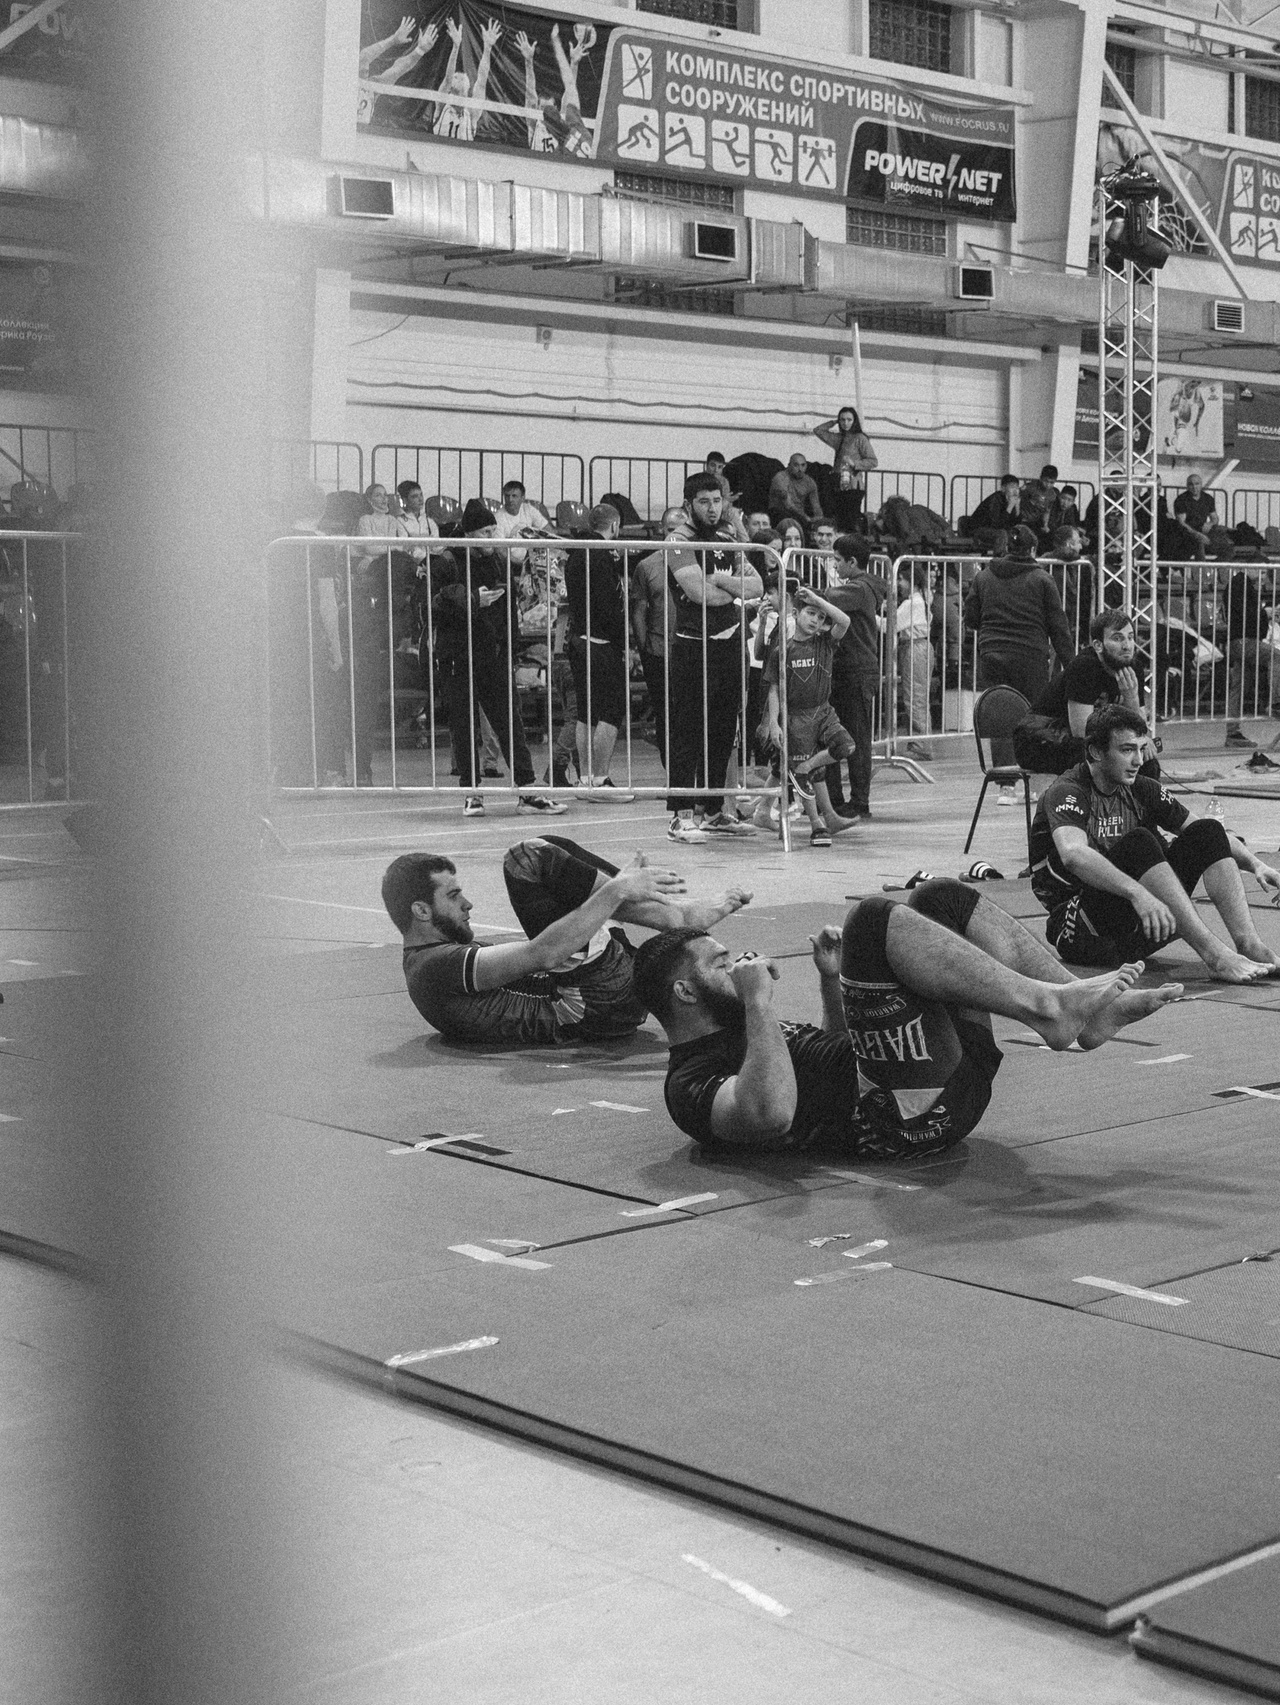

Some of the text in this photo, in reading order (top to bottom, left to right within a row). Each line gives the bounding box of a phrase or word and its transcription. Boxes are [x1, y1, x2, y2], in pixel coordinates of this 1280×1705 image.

[665, 50, 927, 123] КОМПЛЕКС СПОРТИВНЫХ
[665, 81, 815, 129] СООРУЖЕНИЙ
[864, 149, 1003, 193] POWER NET
